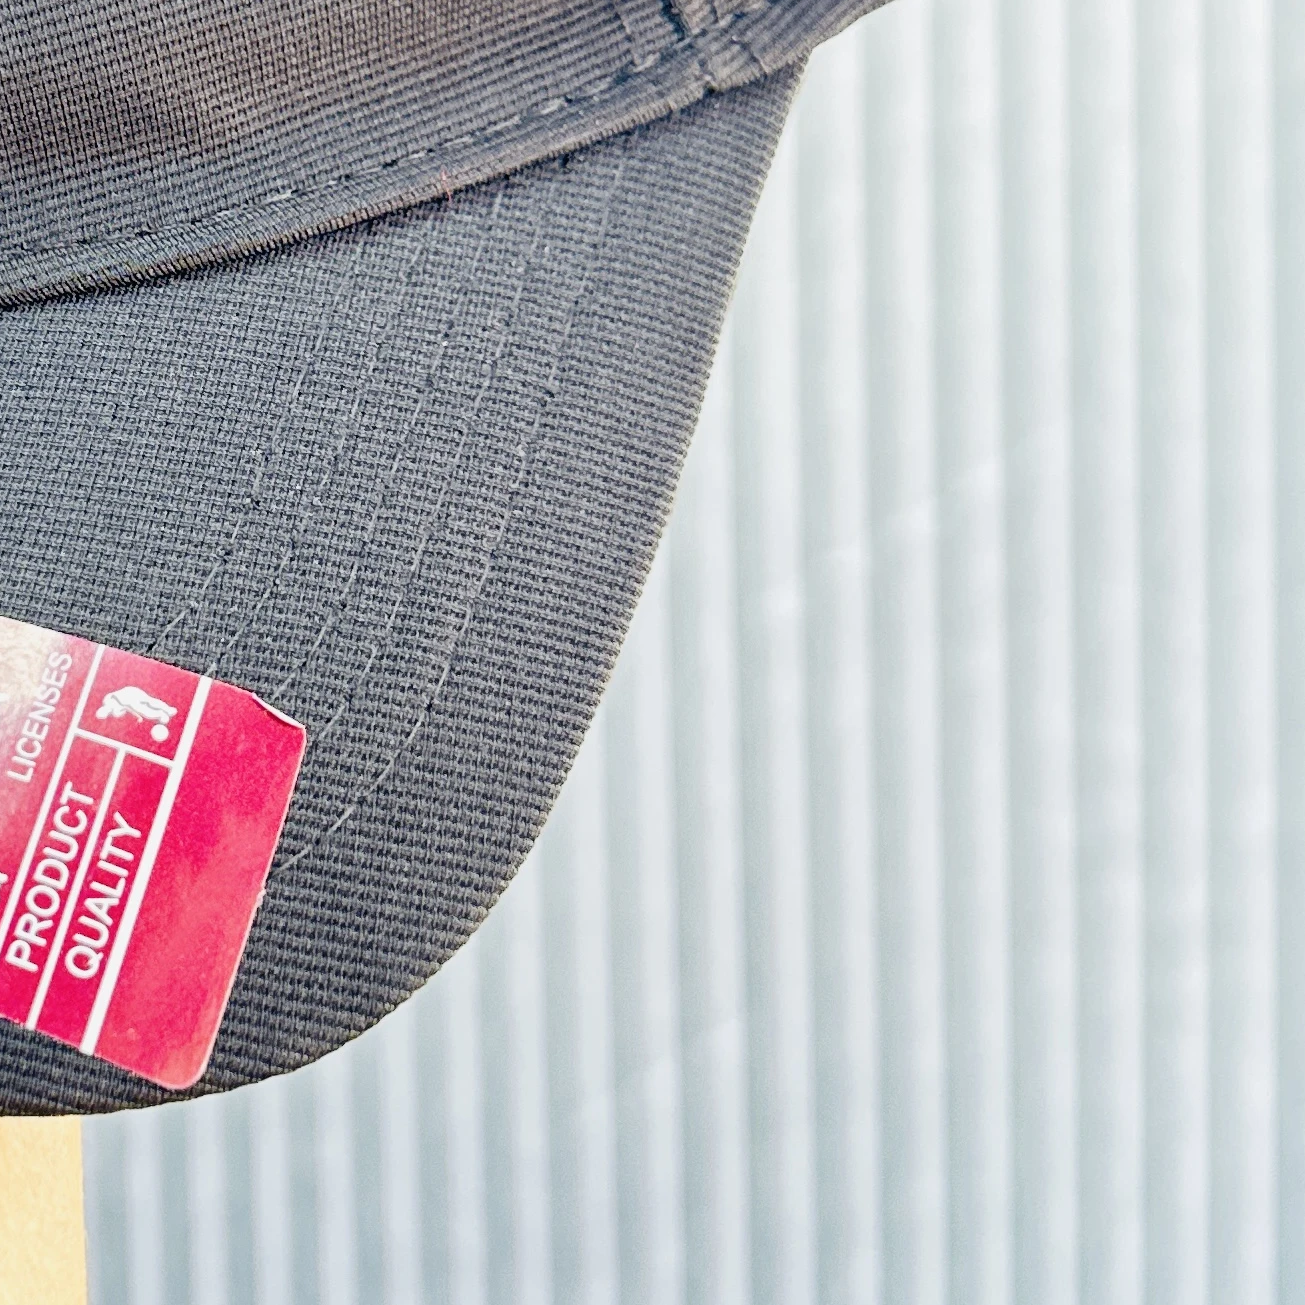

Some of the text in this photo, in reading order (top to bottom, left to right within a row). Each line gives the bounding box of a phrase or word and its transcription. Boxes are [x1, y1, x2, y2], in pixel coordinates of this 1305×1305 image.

[7, 651, 73, 783] LICENSES
[4, 780, 95, 973] PRODUCT
[64, 810, 143, 980] QUALITY
